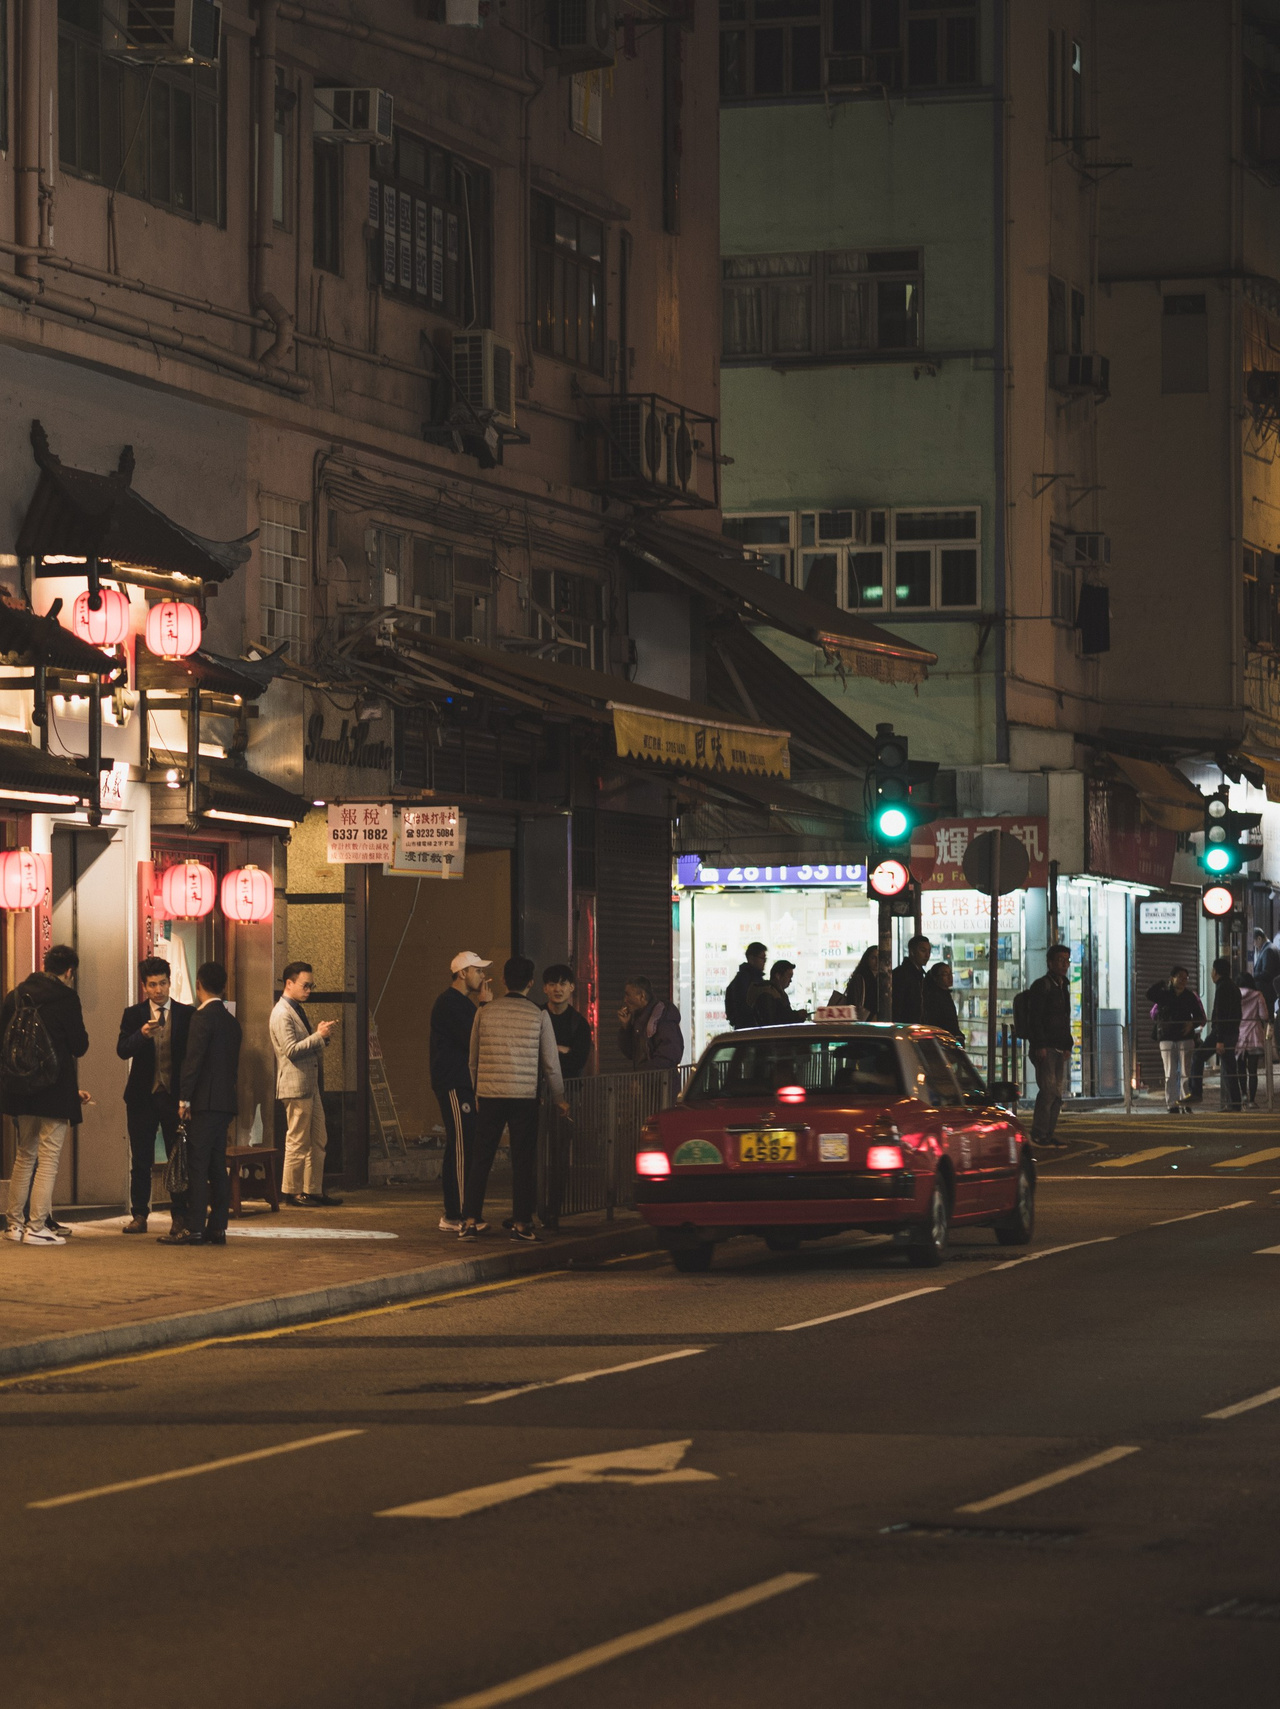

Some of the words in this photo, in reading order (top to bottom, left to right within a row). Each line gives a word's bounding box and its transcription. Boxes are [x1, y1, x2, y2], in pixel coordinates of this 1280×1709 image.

[341, 808, 380, 826] 報稅
[332, 829, 359, 840] 6337
[363, 829, 388, 840] 1882
[416, 829, 435, 838] 9232
[405, 851, 455, 864] 浸信教會
[963, 919, 1015, 930] EXCHNGE
[821, 948, 842, 956] 580
[817, 1006, 852, 1019] TAXI
[744, 1146, 792, 1160] 4587
